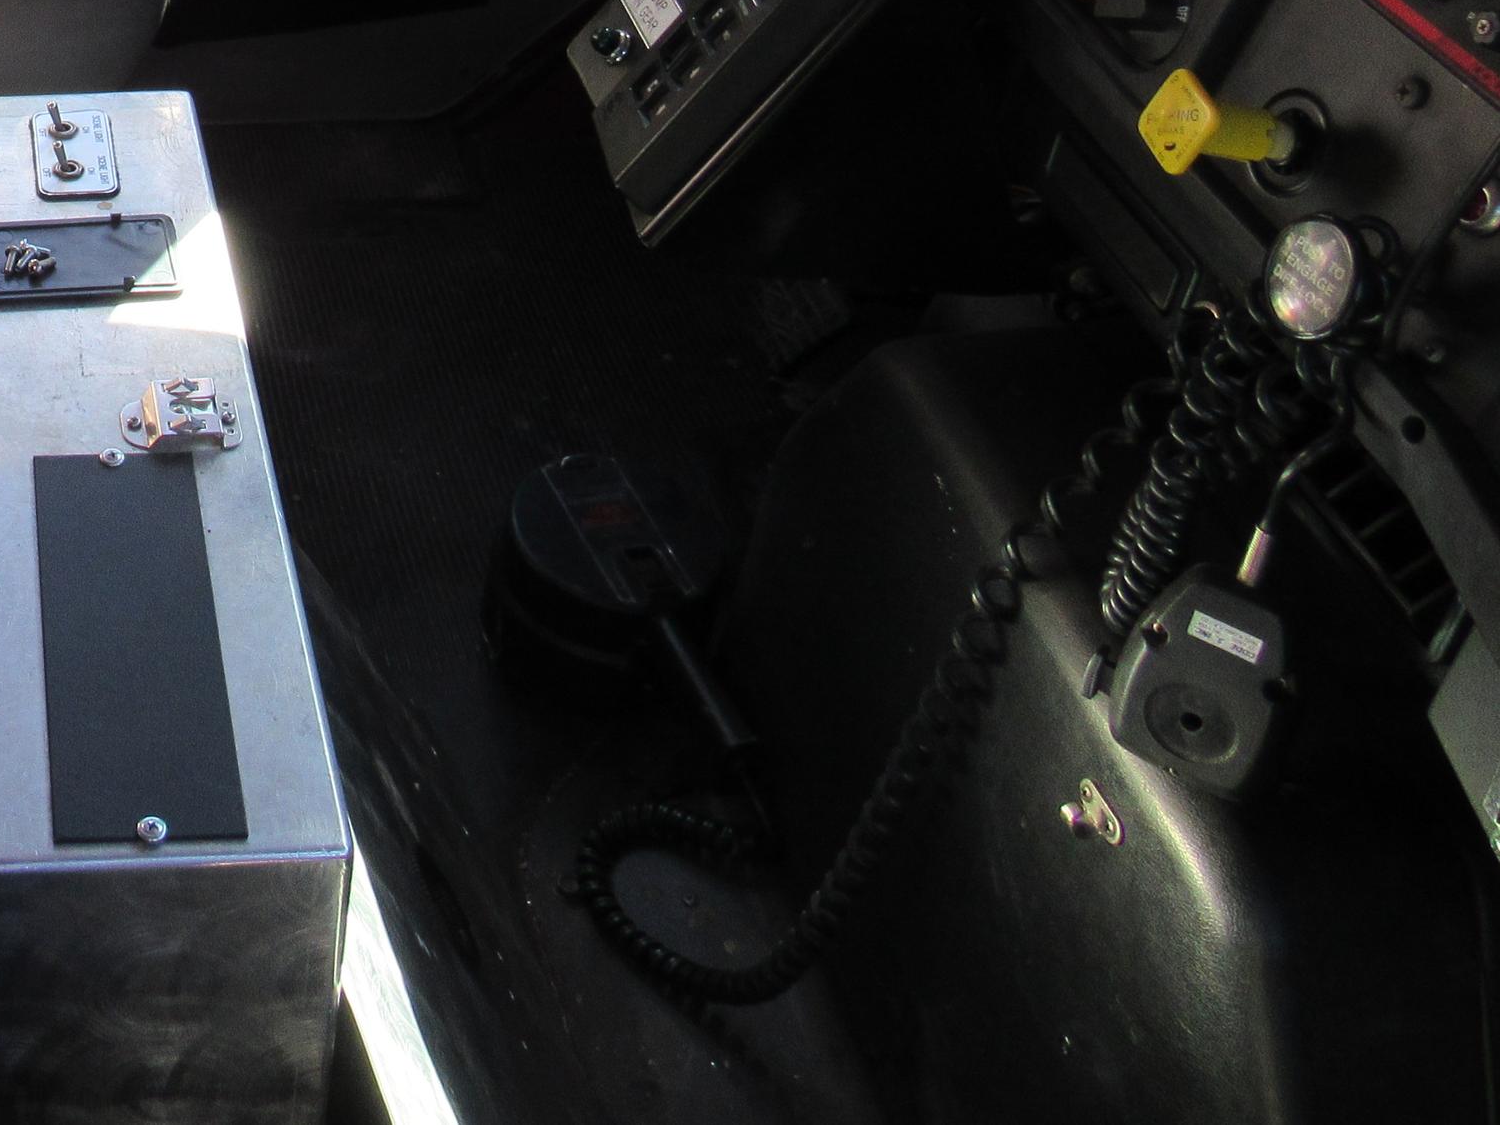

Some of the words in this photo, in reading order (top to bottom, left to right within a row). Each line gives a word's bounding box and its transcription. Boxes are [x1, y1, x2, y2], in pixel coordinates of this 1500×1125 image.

[639, 6, 659, 30] GEAR
[1176, 6, 1189, 23] OFF
[1286, 252, 1335, 296] ENGAGE
